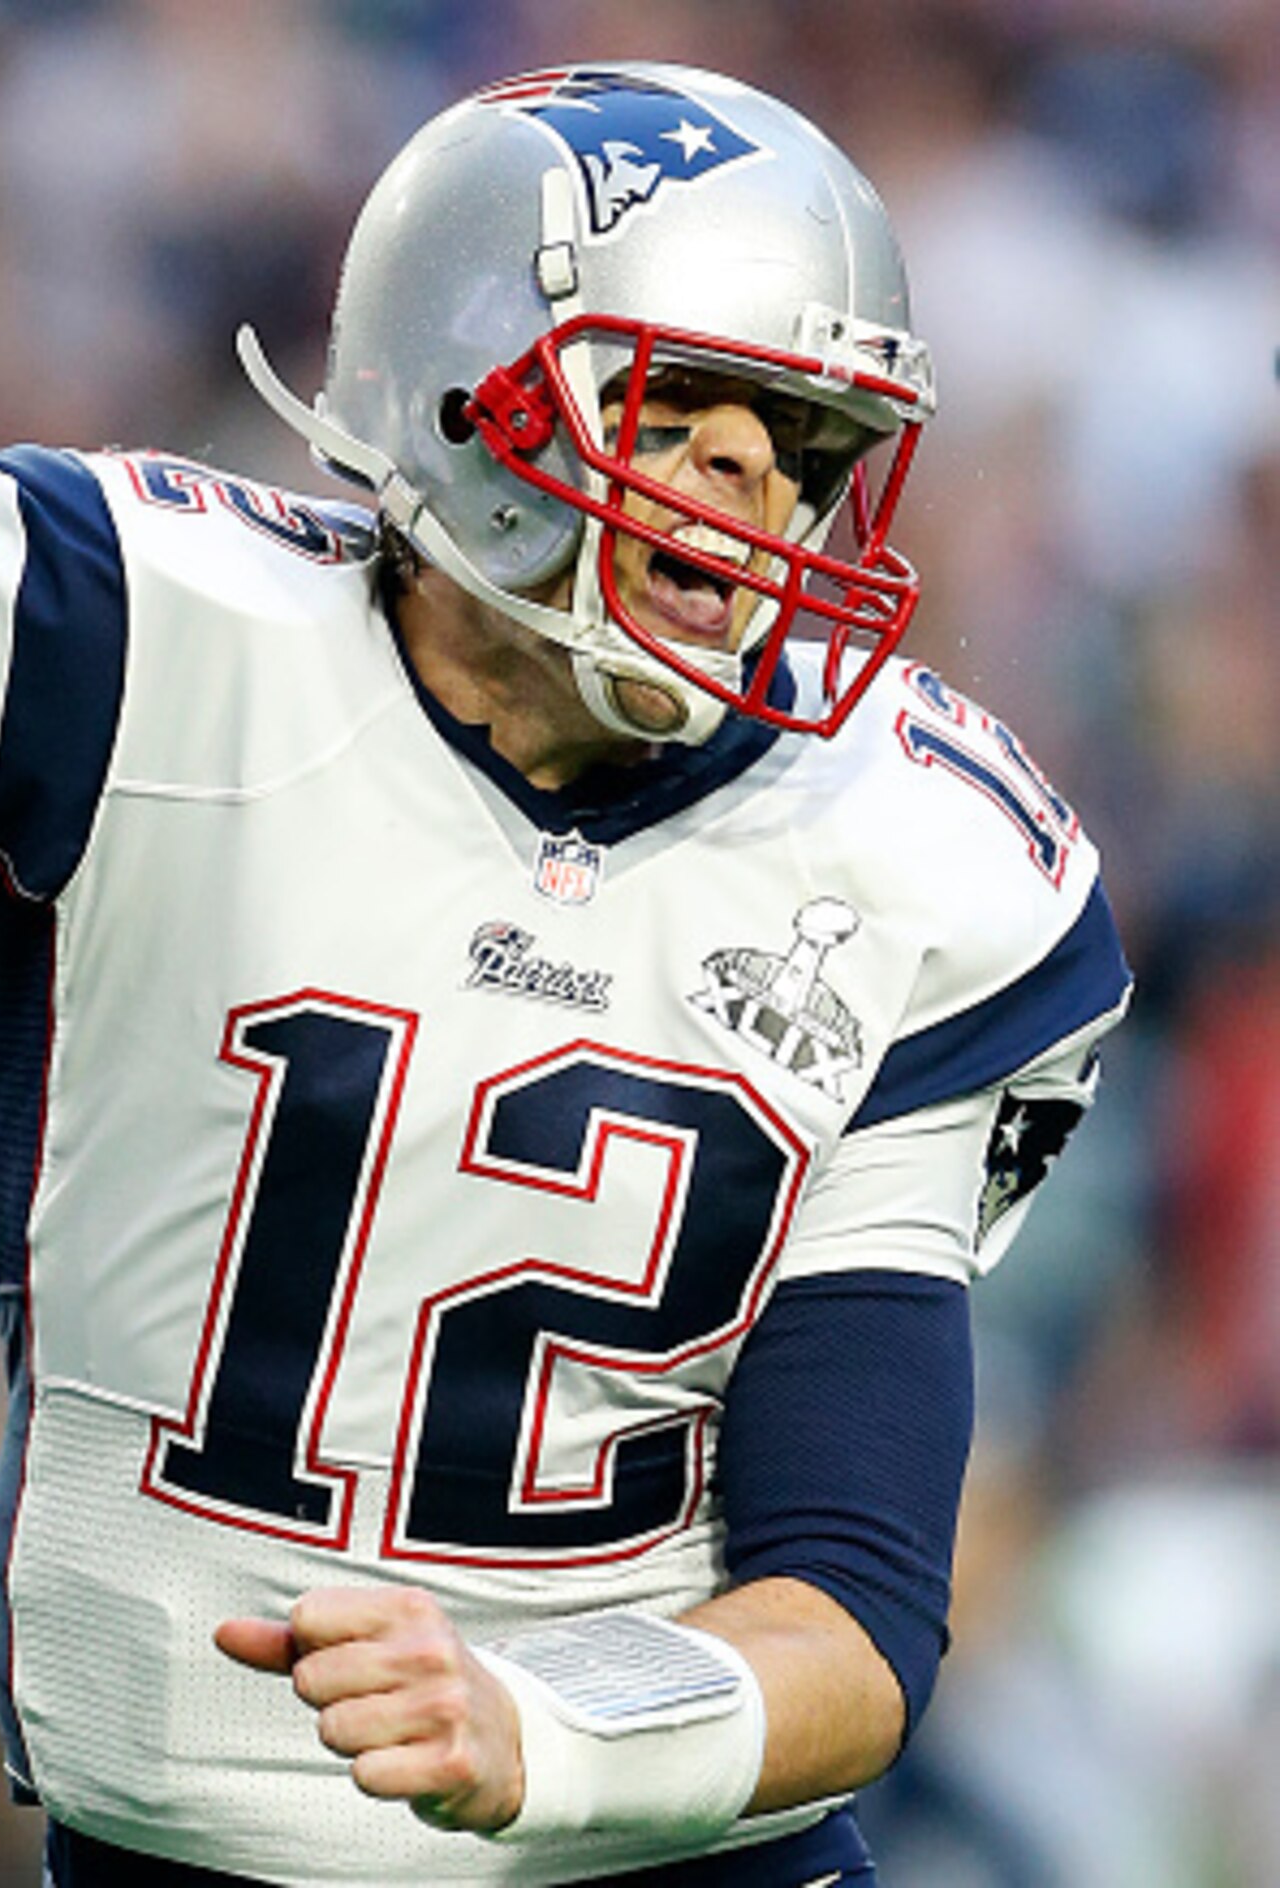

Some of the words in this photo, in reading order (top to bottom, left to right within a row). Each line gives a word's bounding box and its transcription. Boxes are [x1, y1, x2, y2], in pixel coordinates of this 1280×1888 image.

[541, 858, 590, 898] NFL
[686, 966, 863, 1105] XLIX
[139, 987, 811, 1569] 12
